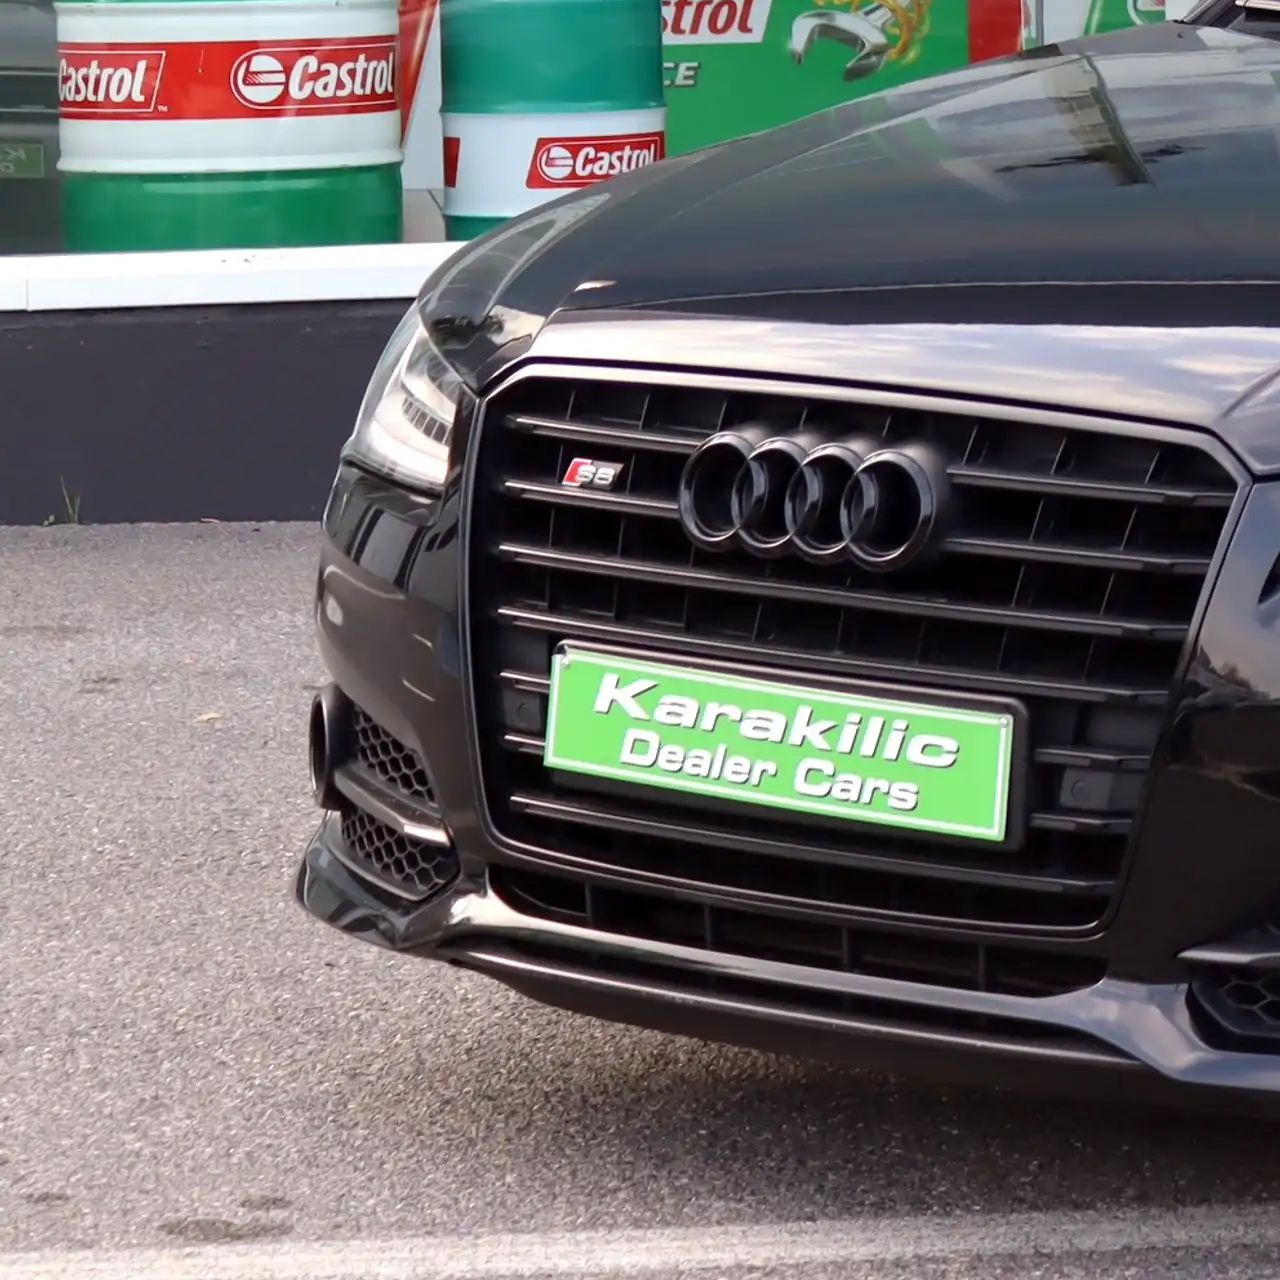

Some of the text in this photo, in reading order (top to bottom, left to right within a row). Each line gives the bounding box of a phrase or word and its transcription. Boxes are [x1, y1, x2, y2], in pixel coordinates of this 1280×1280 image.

[59, 58, 148, 102] Castrol
[288, 51, 395, 100] Castrol
[574, 464, 616, 486] S8
[592, 672, 961, 769] Karakilic
[618, 727, 921, 813] Dealer Cars
